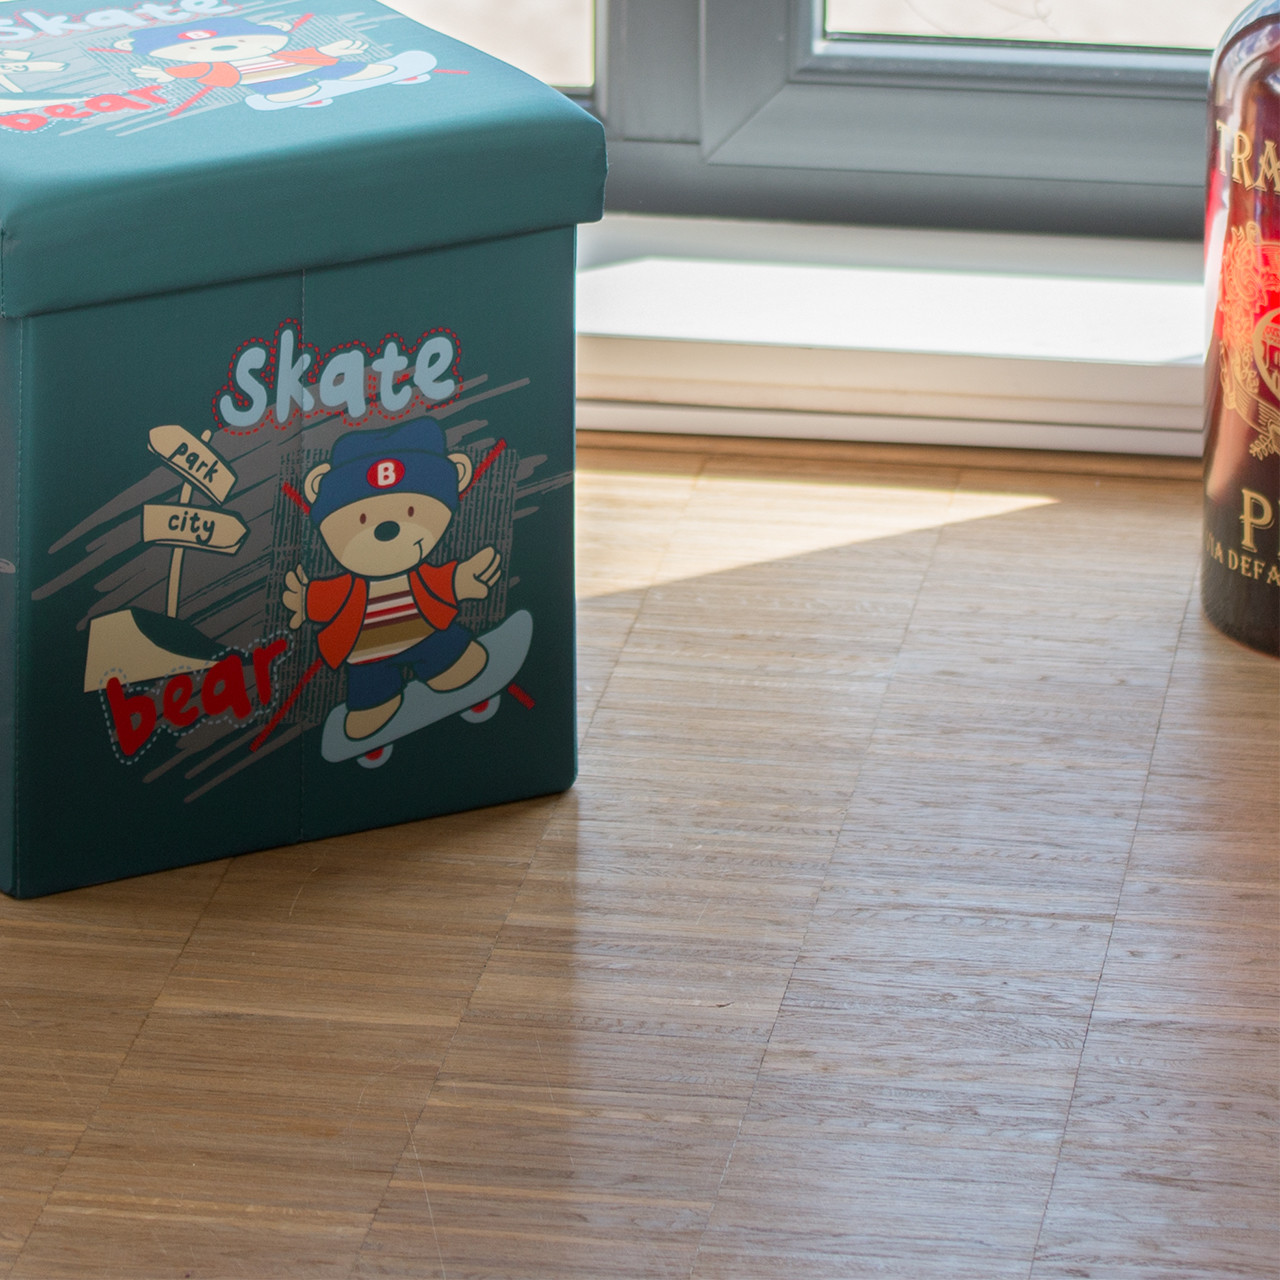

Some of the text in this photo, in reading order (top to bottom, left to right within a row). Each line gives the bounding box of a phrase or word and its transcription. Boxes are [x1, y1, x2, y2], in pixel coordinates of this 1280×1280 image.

[220, 329, 455, 427] Skate
[168, 441, 220, 484] park
[376, 462, 397, 487] B
[168, 511, 216, 545] city
[105, 639, 288, 757] bear
